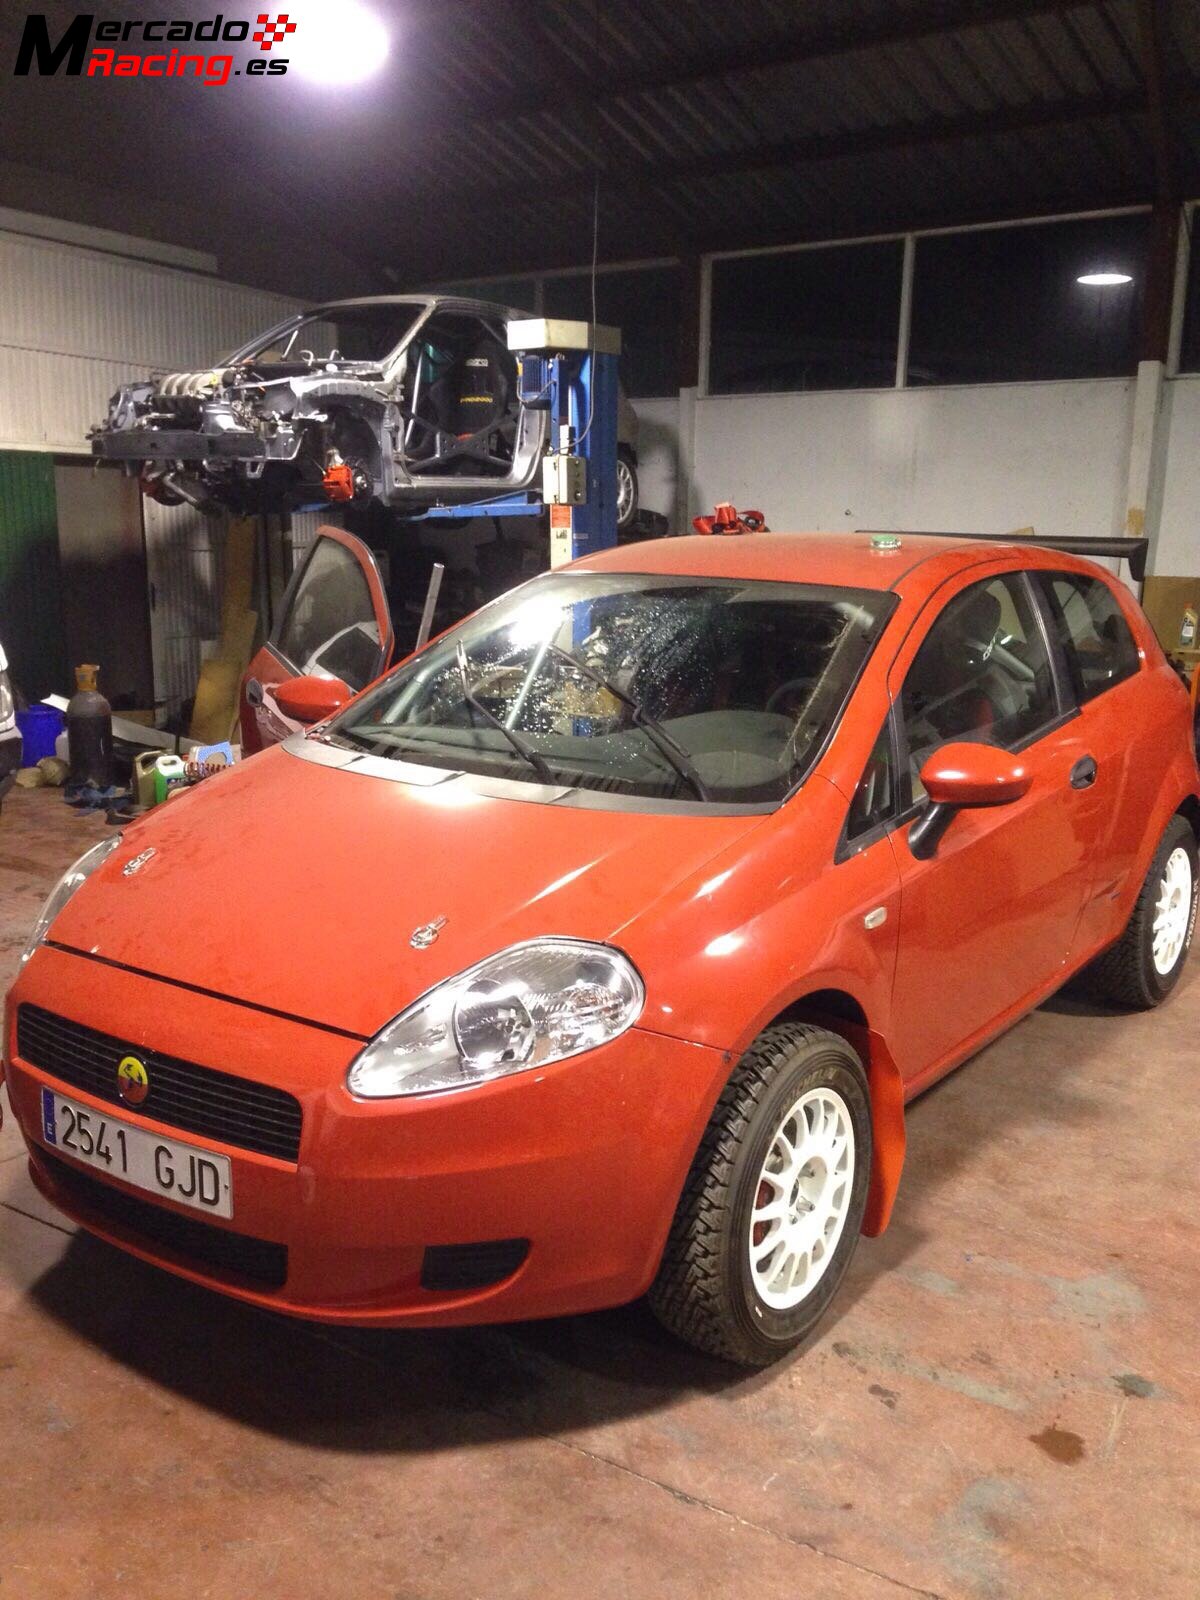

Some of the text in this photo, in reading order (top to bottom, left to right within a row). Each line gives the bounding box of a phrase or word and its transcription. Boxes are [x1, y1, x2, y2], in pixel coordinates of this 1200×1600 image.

[47, 1122, 54, 1135] E
[61, 1105, 220, 1206] 2541 GJD
